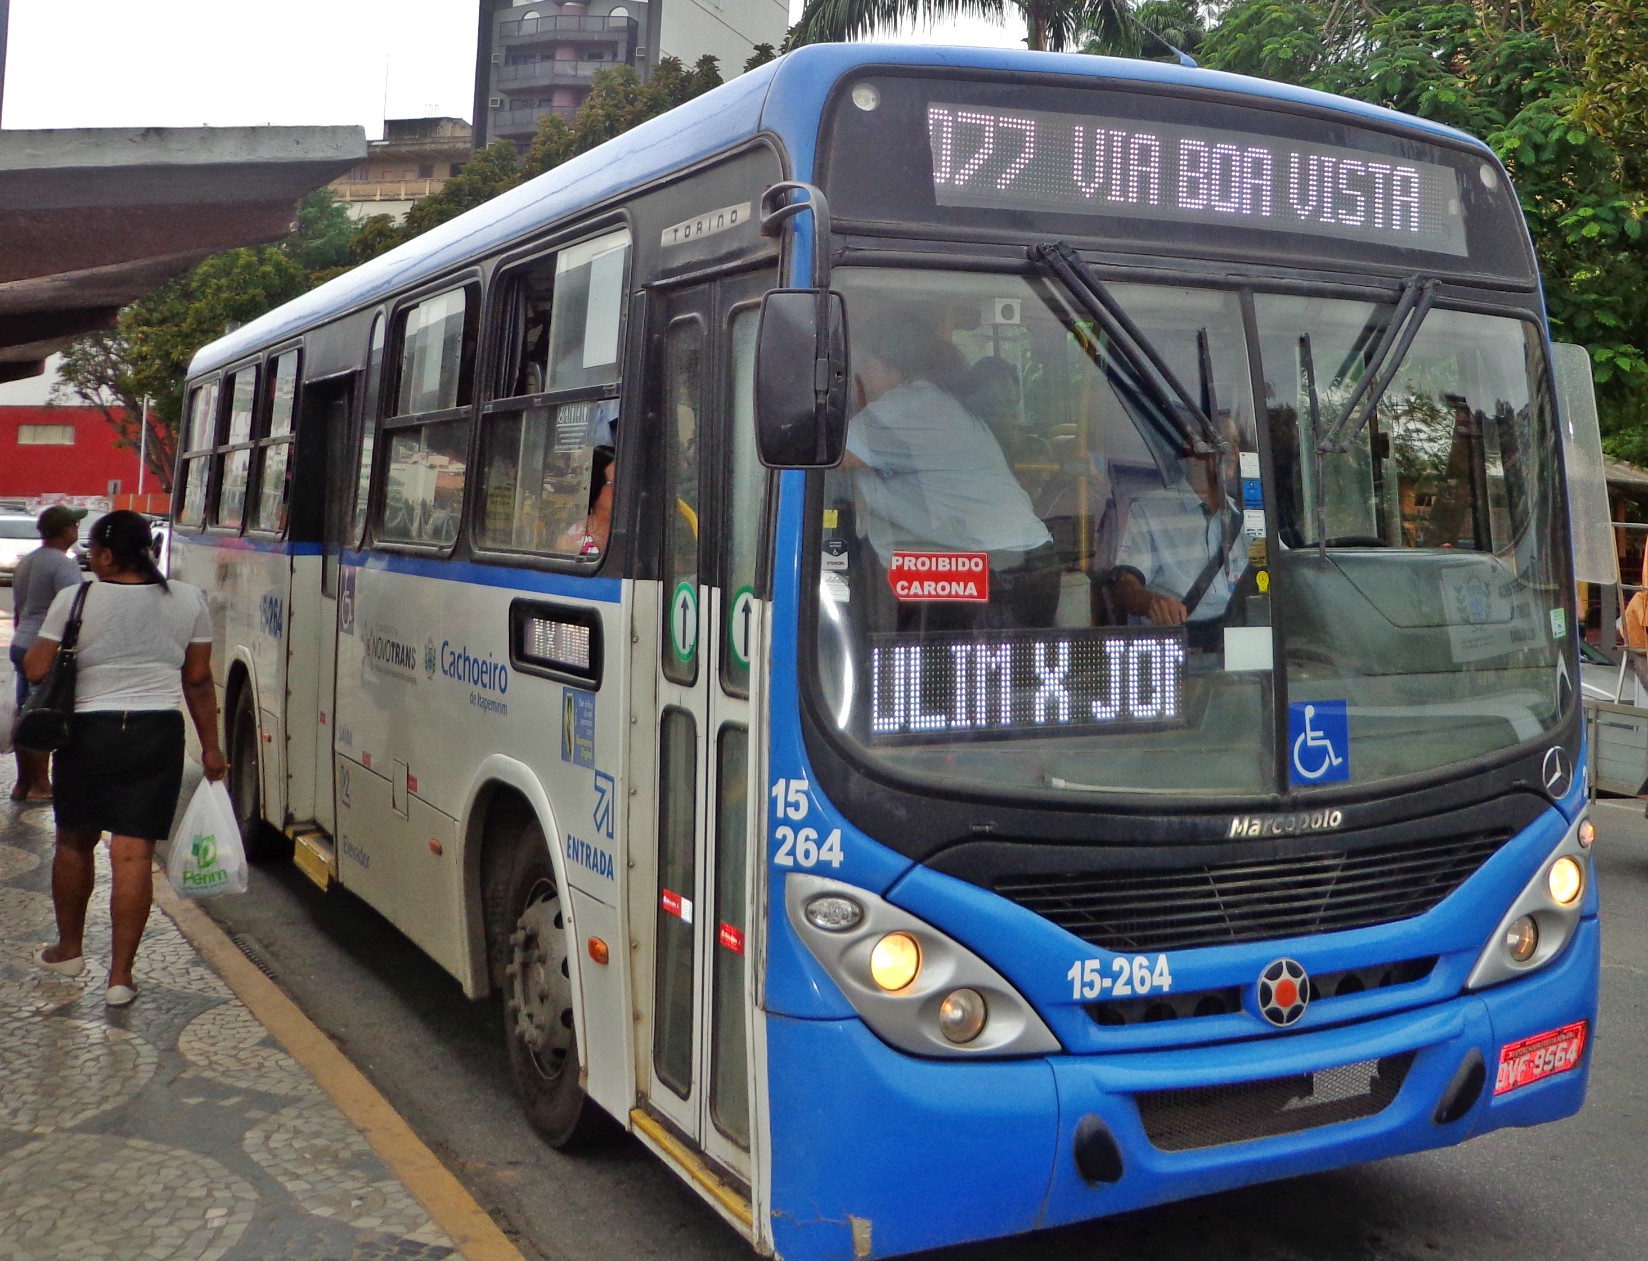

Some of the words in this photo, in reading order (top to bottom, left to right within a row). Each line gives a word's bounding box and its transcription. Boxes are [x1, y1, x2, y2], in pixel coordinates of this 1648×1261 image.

[1072, 125, 1160, 205] VIA
[1178, 138, 1271, 217] BOA
[1288, 151, 1419, 233] VISTA
[673, 209, 738, 242] TORINO
[891, 555, 984, 572] PROIBIDO
[895, 580, 978, 596] CARONA
[440, 639, 508, 695] Cachoeiro
[1035, 641, 1069, 724] X
[469, 690, 477, 706] de
[771, 777, 809, 821] 15
[566, 833, 614, 882] ENTRADA
[773, 825, 845, 869] 264
[1067, 953, 1173, 1000] 15-264
